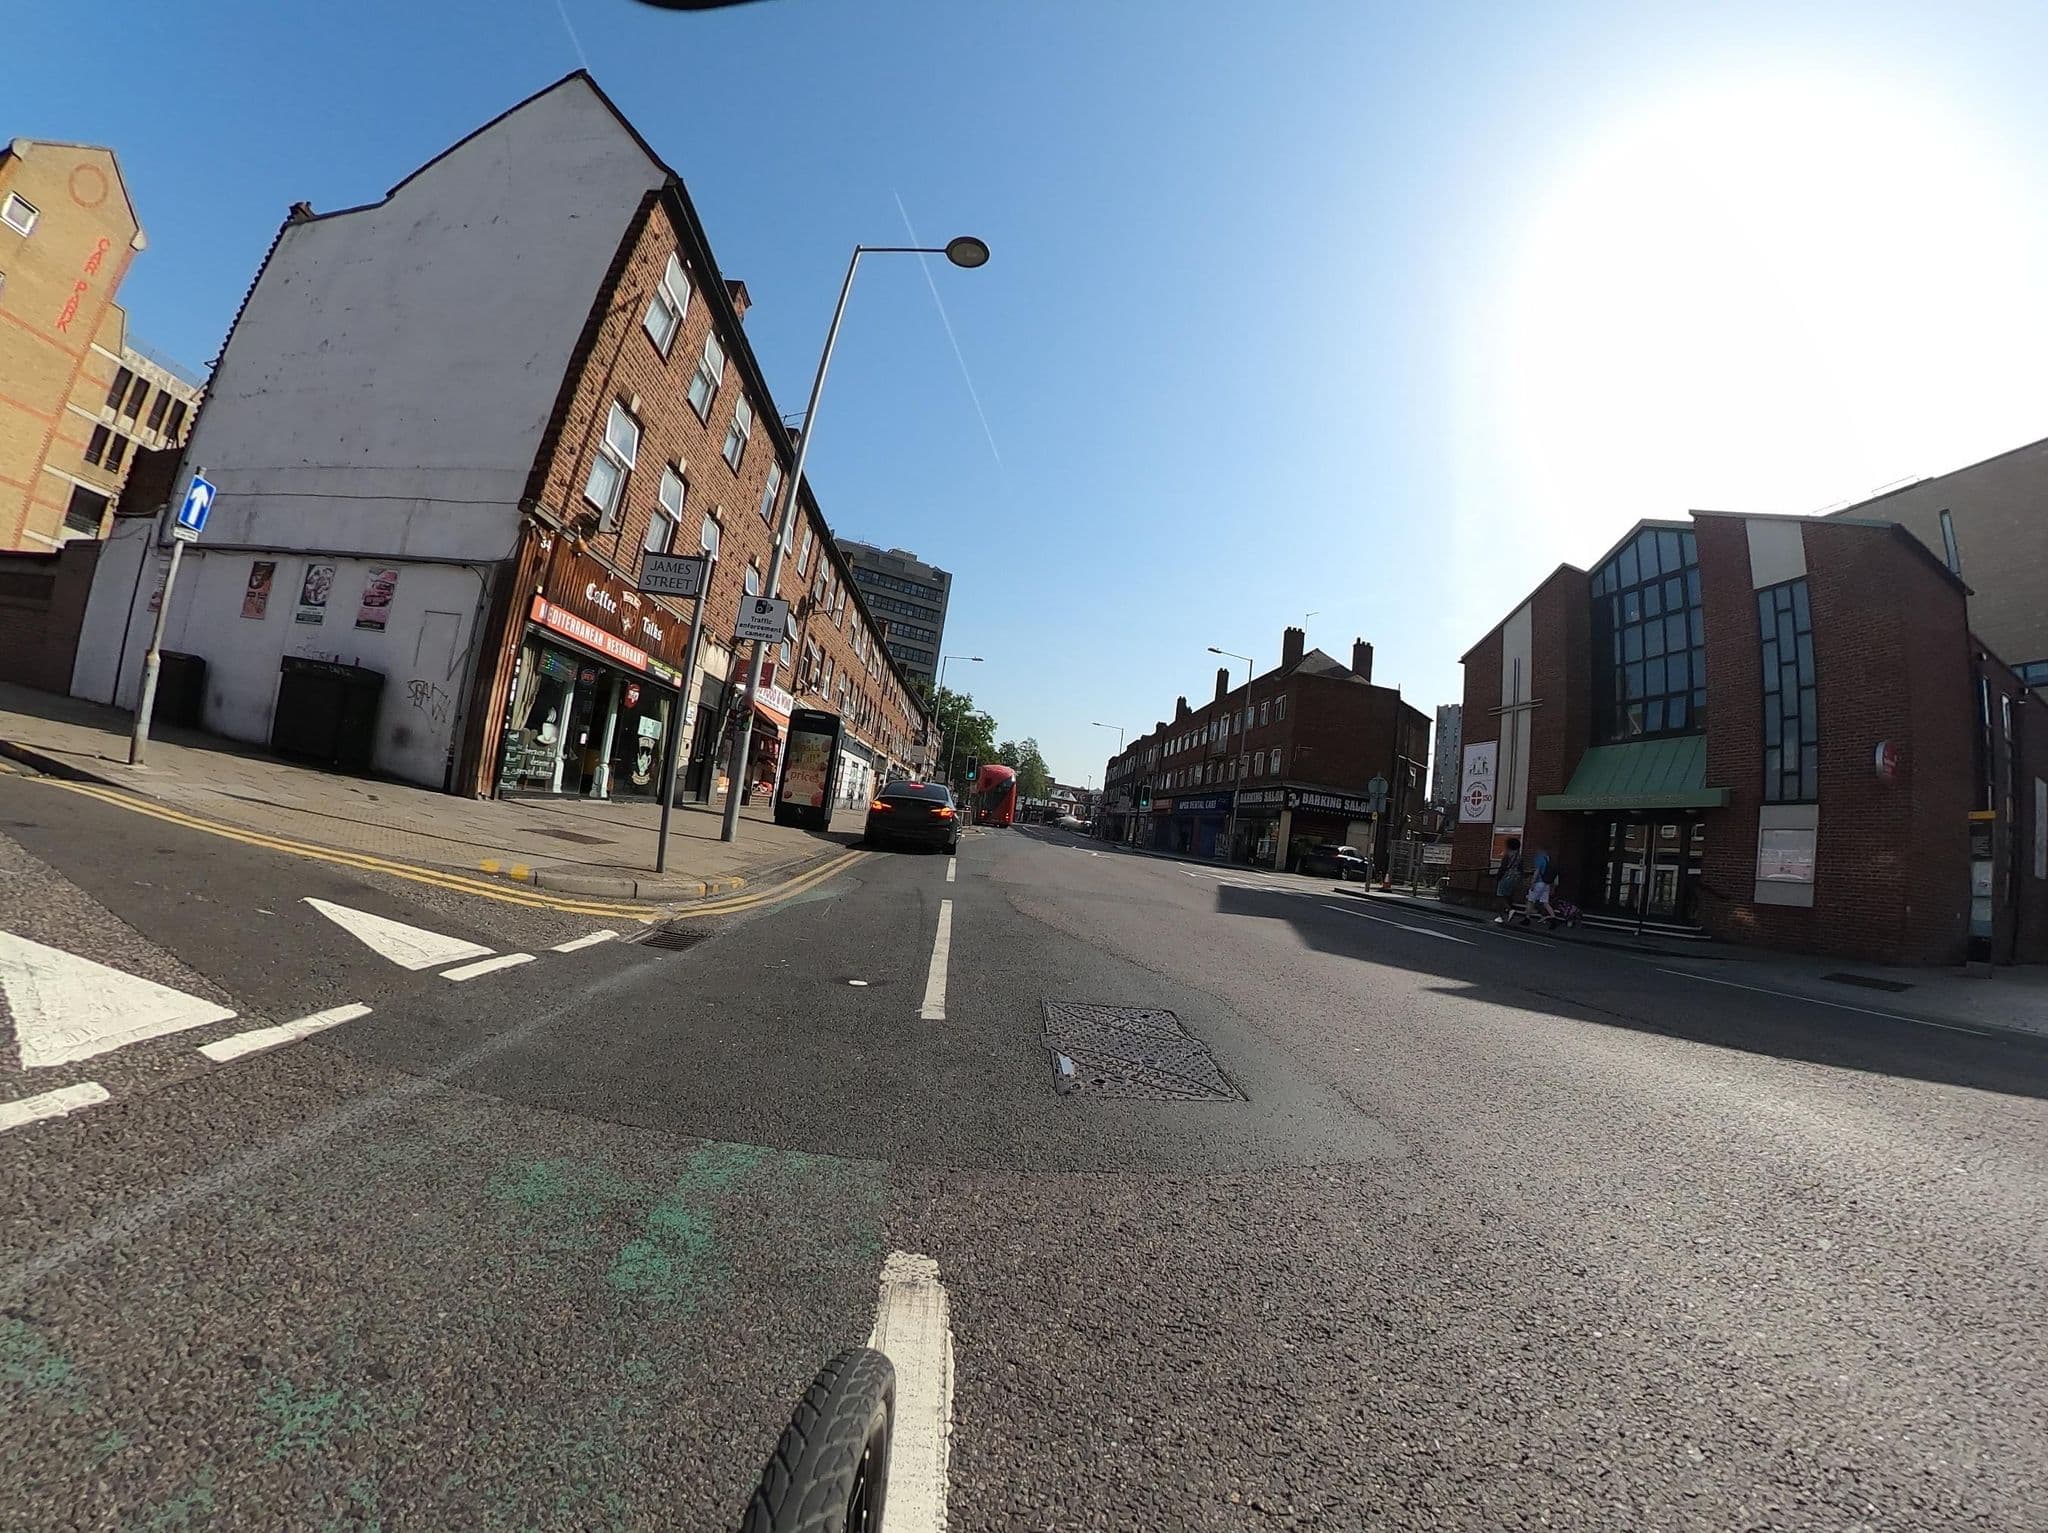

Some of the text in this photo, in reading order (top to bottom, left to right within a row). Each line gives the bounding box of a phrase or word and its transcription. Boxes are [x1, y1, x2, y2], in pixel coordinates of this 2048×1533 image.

[57, 238, 110, 334] CAR PARK
[540, 538, 552, 552] 34
[650, 559, 692, 575] JAMES
[645, 575, 693, 591] STREET
[585, 582, 618, 614] Coffee
[739, 622, 782, 633] enforcement
[750, 615, 773, 625] Traffic
[539, 603, 646, 667] MEDITERRANEAN RESTAURANT
[744, 630, 773, 639] cameras
[1240, 790, 1285, 803] BARKING SALON
[1302, 793, 1342, 809] BARKING
